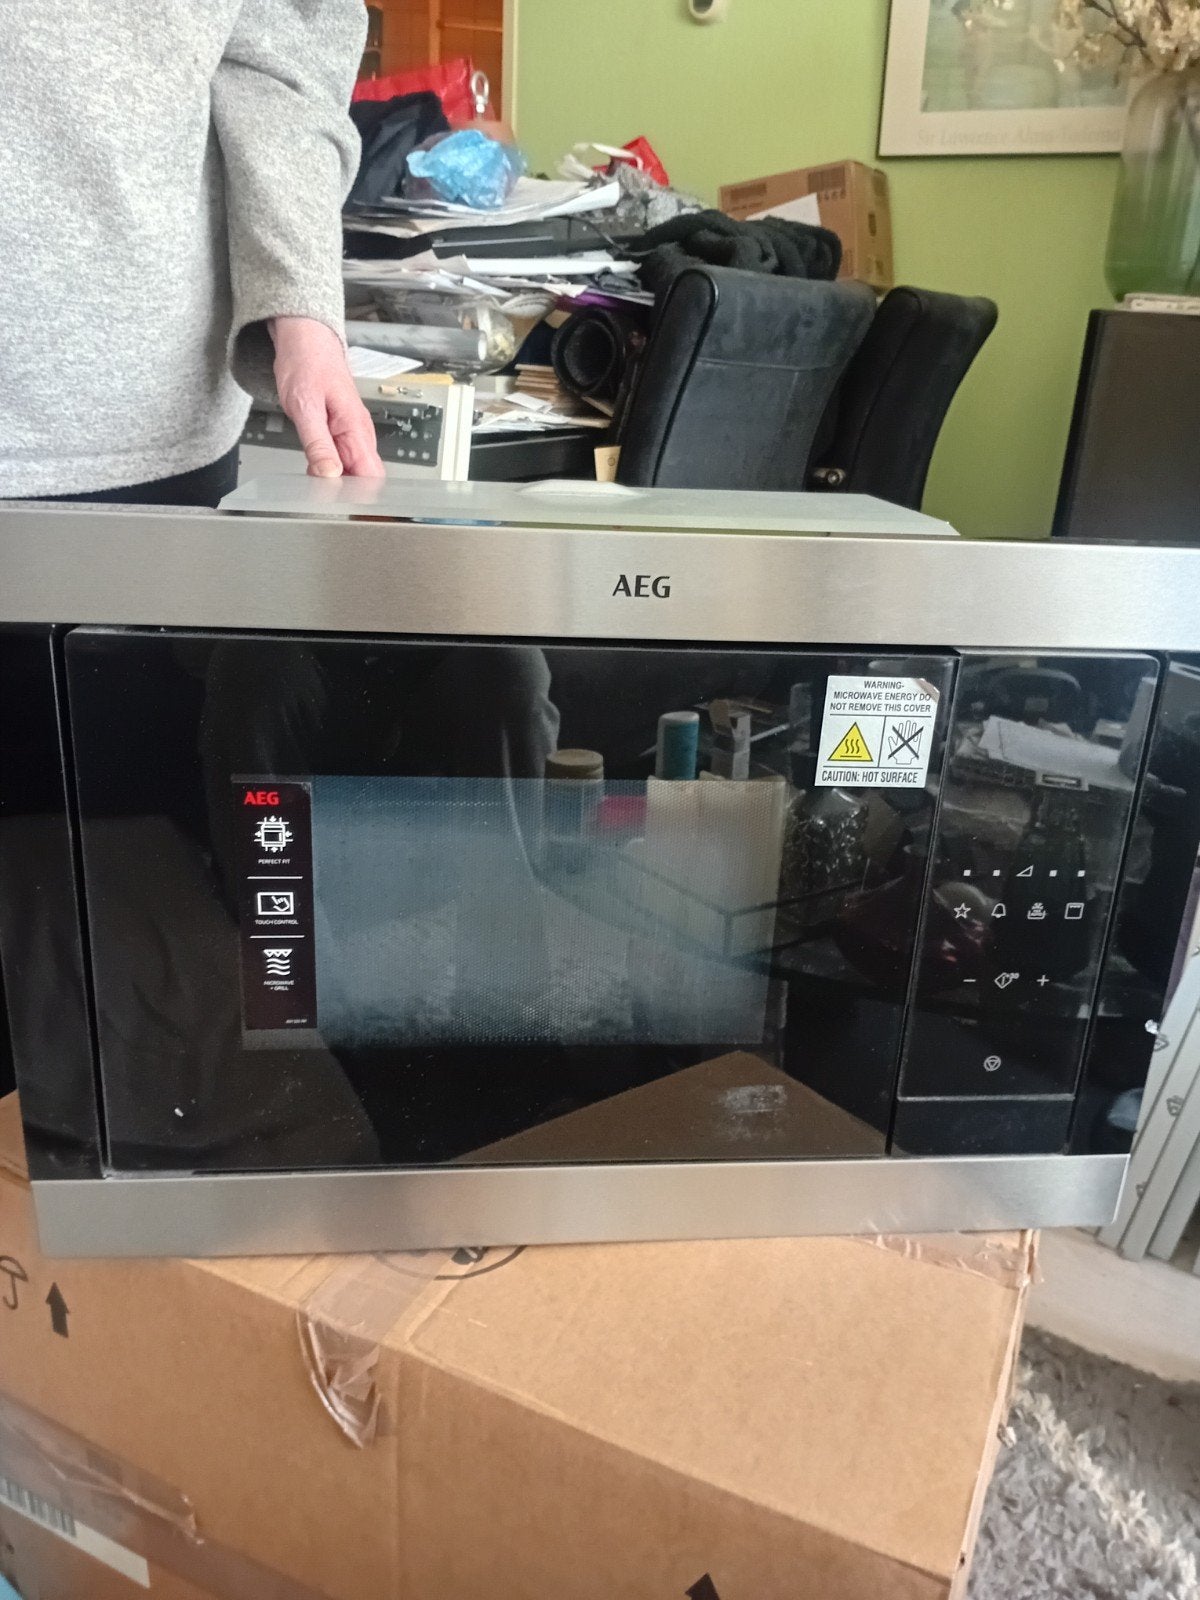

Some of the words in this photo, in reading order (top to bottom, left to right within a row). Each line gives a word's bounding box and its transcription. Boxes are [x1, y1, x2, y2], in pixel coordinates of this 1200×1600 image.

[612, 574, 671, 599] AEG
[833, 691, 883, 701] MICROWAVE
[884, 692, 918, 702] ENERGY
[919, 693, 932, 702] DO
[829, 702, 848, 712] NOT
[848, 702, 883, 712] REMOVE
[884, 703, 902, 712] THIS
[903, 704, 931, 713] COVER
[821, 770, 861, 783] CAUTION:
[861, 771, 880, 783] HOT
[880, 772, 919, 784] SURFACE
[244, 790, 280, 806] AEG
